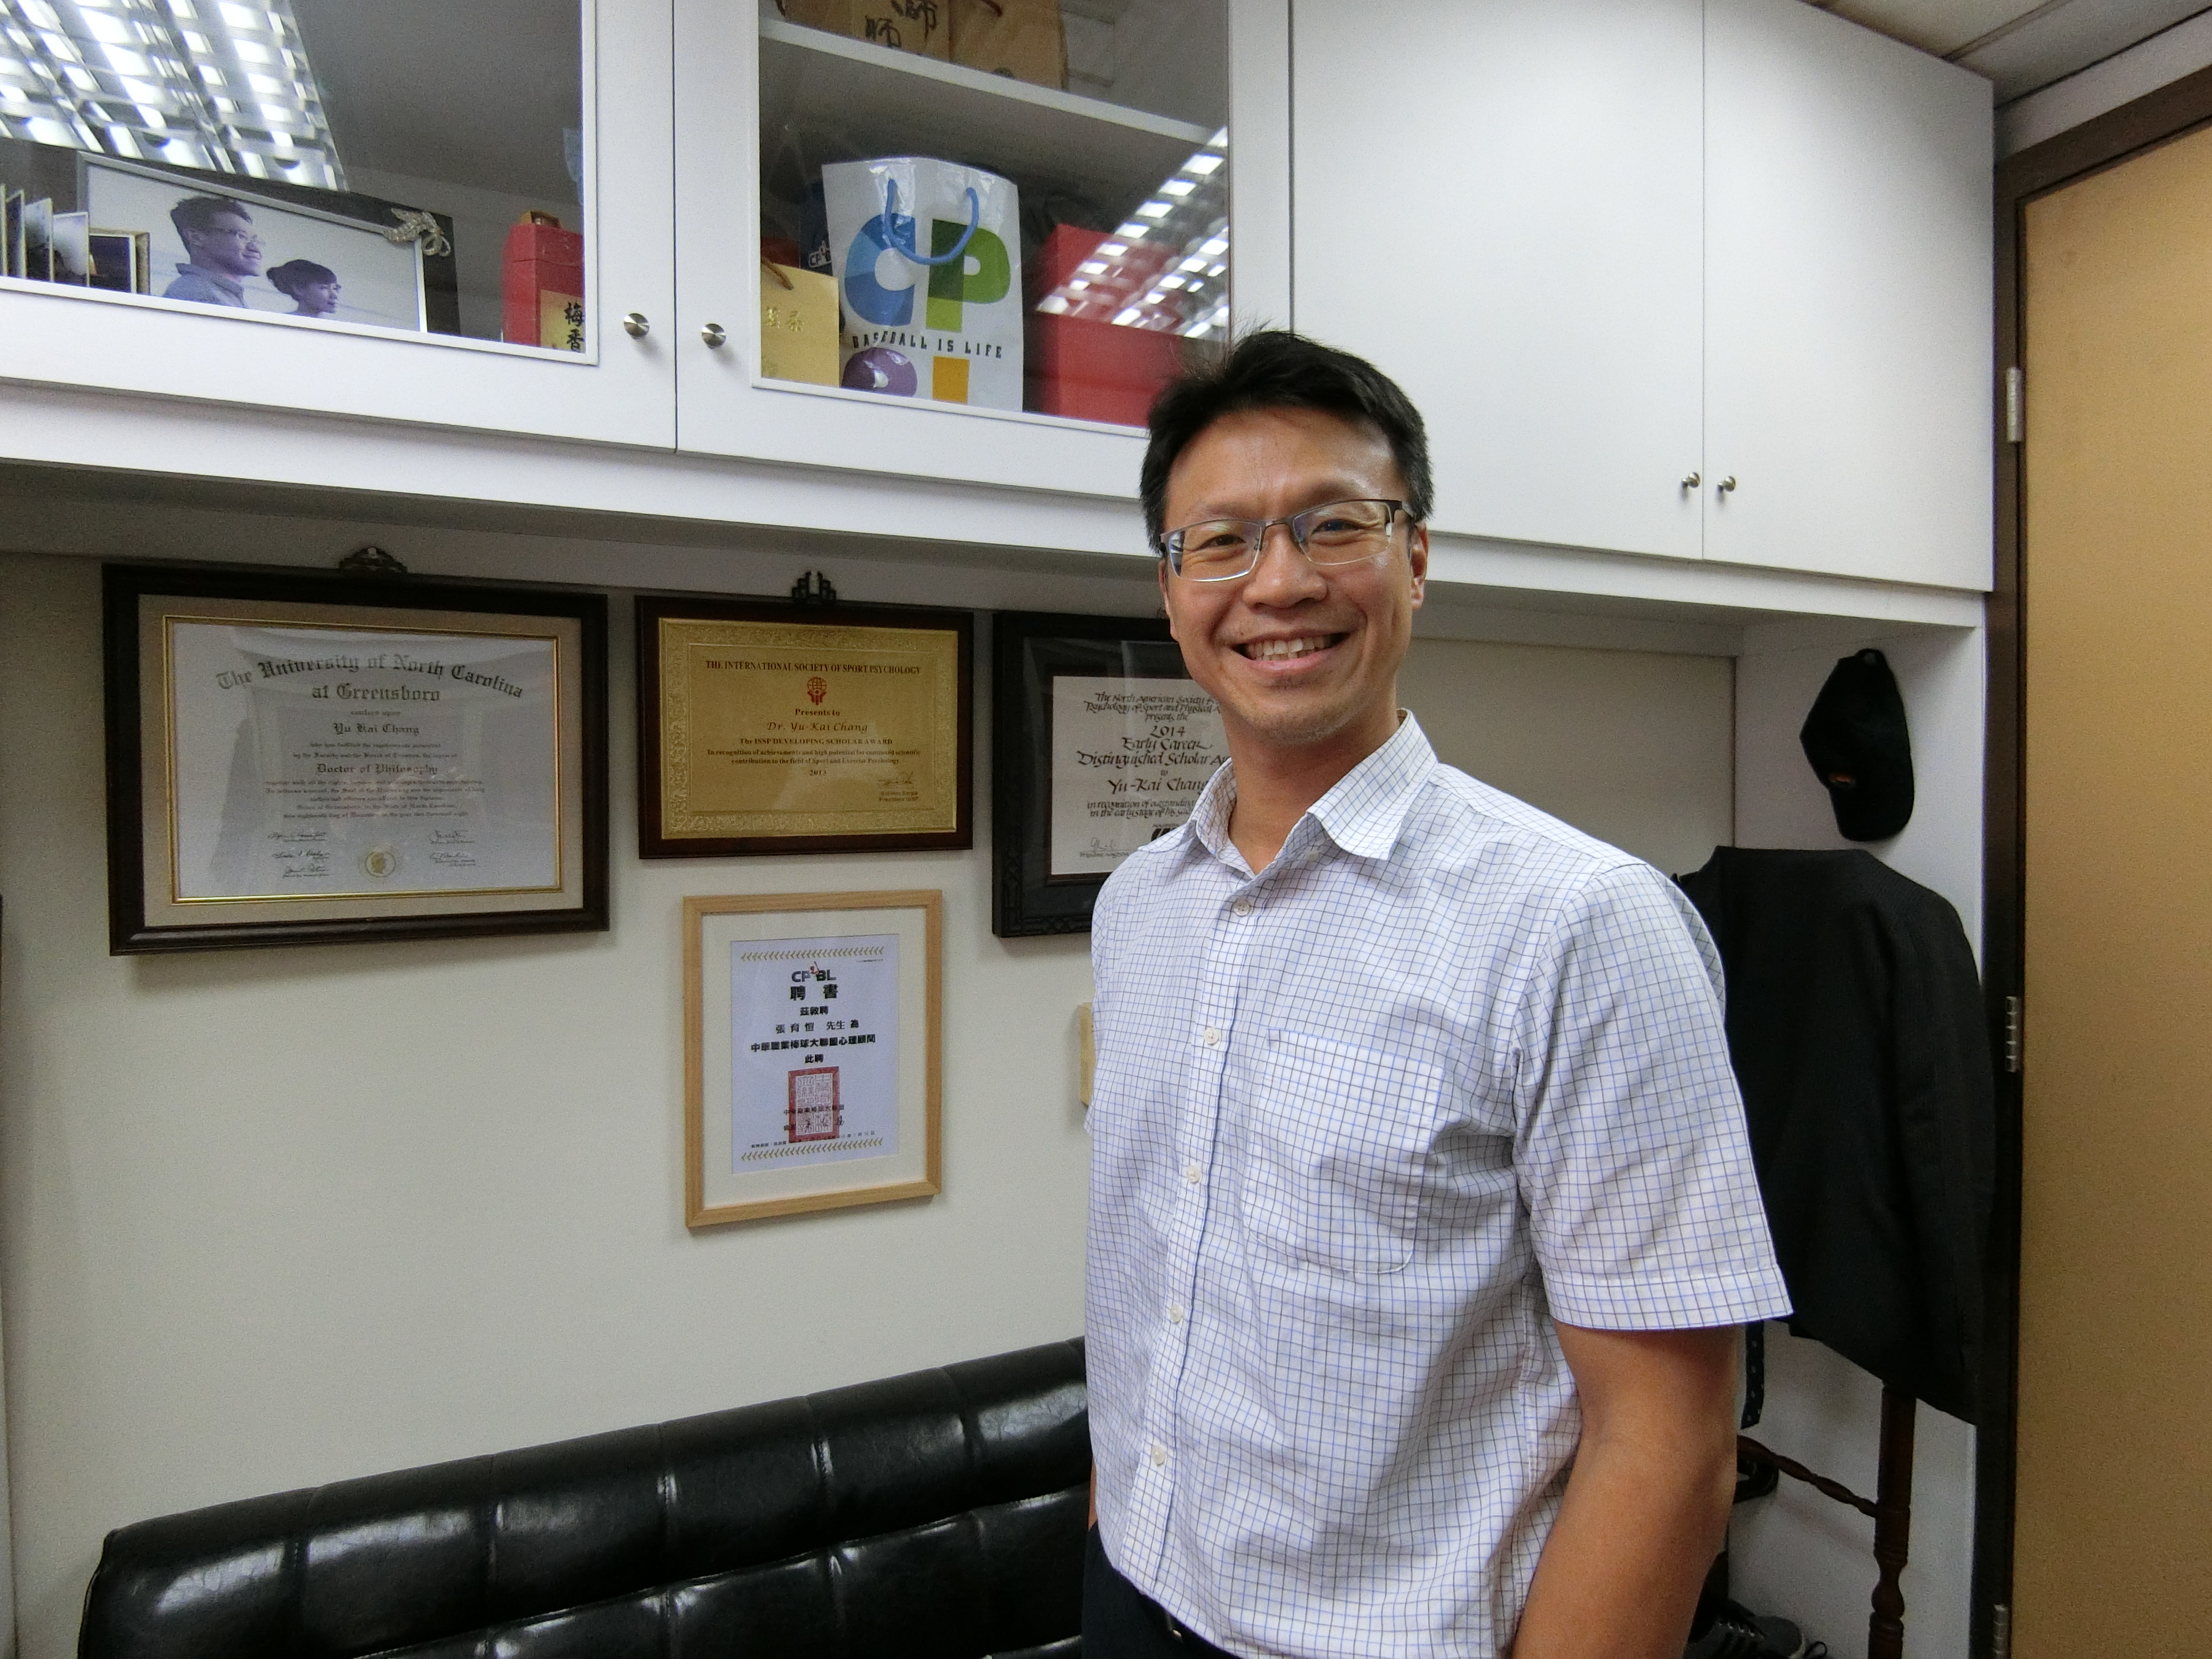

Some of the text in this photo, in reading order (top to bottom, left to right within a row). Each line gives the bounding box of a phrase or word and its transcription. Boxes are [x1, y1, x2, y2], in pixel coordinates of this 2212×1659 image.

[852, 330, 1002, 358] BASEBALL IS LIFE
[706, 660, 723, 669] THE
[724, 661, 794, 671] INTERNATIONAL
[795, 663, 830, 672] SOCIETY
[843, 664, 868, 673] SPORT
[869, 665, 921, 674] PSYCHOLOGY
[216, 654, 523, 698] The University of North Carolina
[312, 683, 440, 701] at Greensboro
[795, 708, 831, 717] Presents
[382, 723, 420, 736] Chang
[768, 722, 786, 731] Dr.
[833, 722, 868, 734] Chang
[1150, 725, 1186, 738] 2014
[1121, 737, 1212, 753] Early Career
[1077, 750, 1164, 769] Distinguished
[1165, 751, 1211, 766] Scholar
[316, 763, 438, 775] Doctor of Philosophy
[1107, 777, 1162, 795] Yu-Kai
[791, 969, 837, 983] CPBL
[790, 984, 838, 1001] 聘書
[826, 1020, 846, 1031] 先生
[805, 1053, 824, 1064] 此聘
